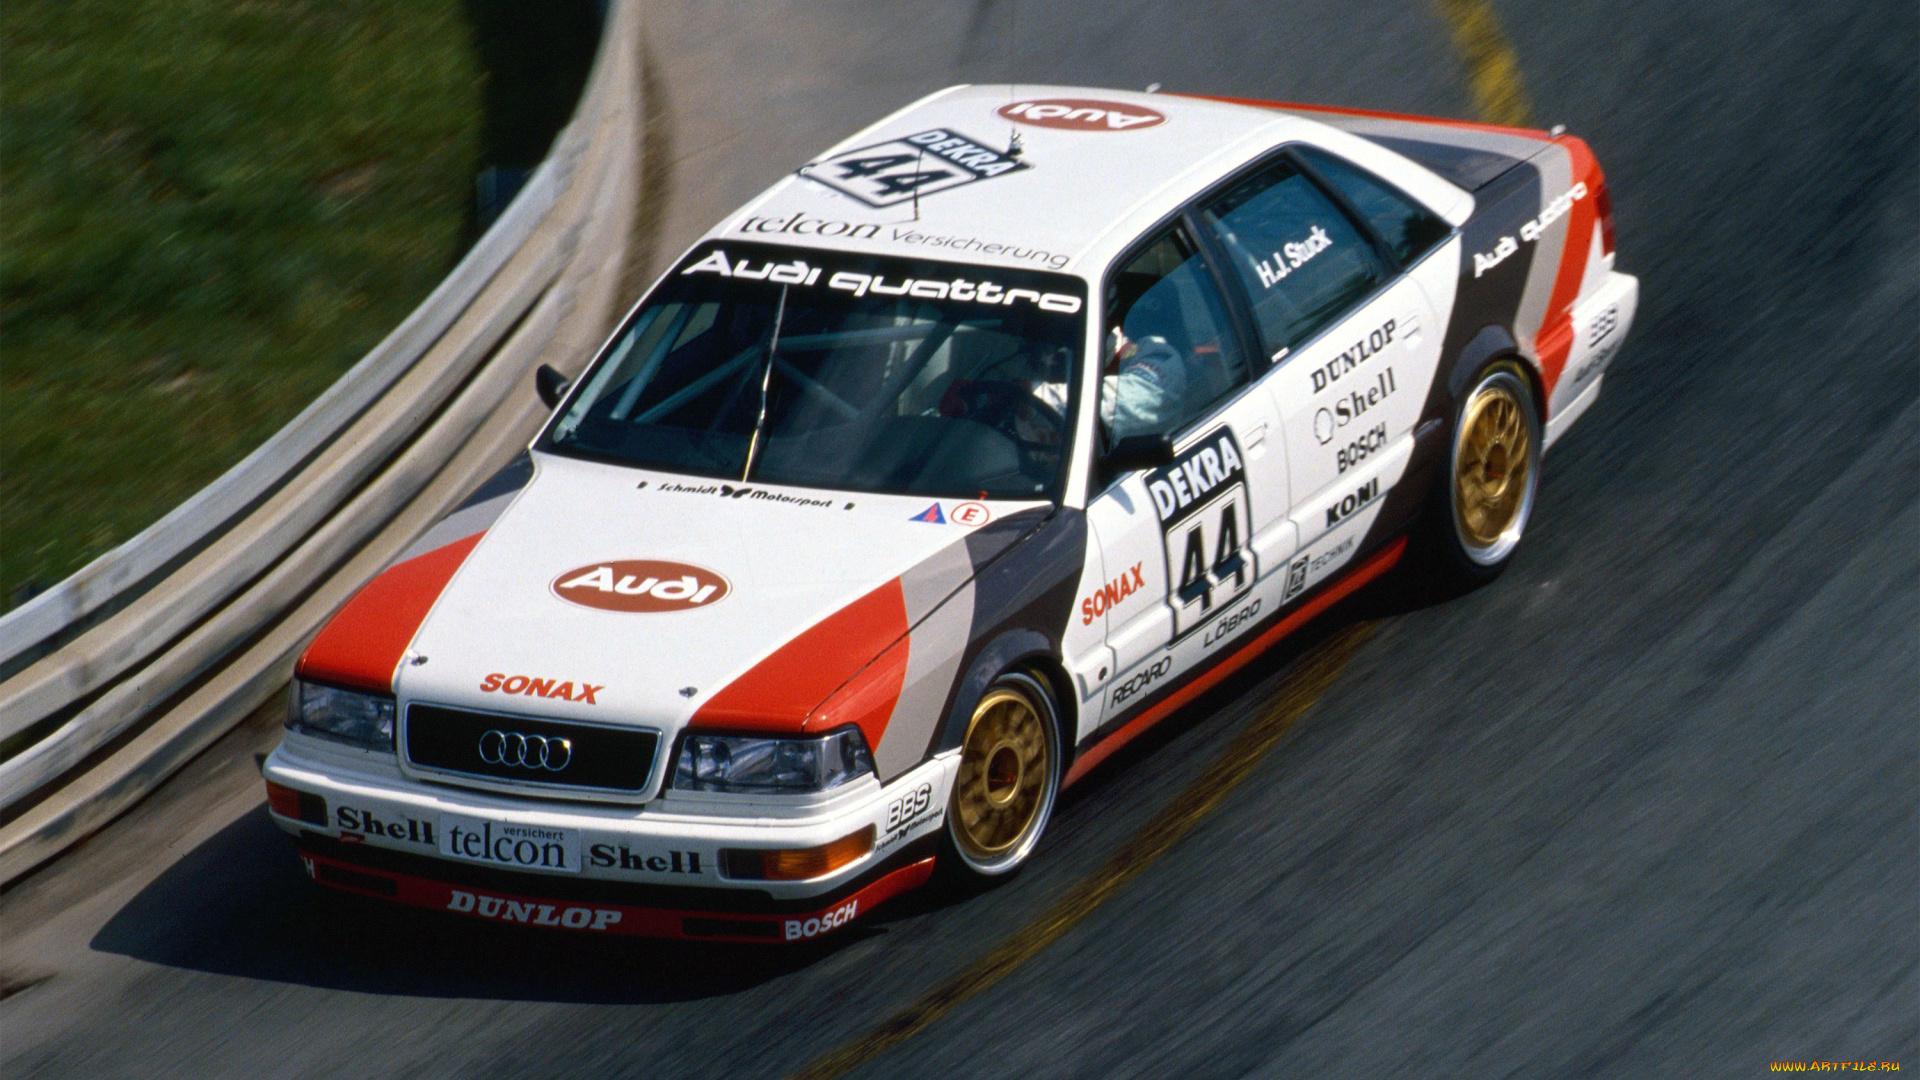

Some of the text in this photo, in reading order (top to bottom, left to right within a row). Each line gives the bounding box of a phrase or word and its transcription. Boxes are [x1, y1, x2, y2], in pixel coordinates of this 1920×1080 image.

[1006, 102, 1160, 129] Audi
[838, 153, 958, 198] 44
[907, 129, 1018, 179] DEKRA
[739, 212, 1073, 271] telcon Versicherung
[1473, 236, 1519, 279] Audi
[680, 250, 1082, 314] Audi quattro
[1310, 318, 1397, 394] DUNLOP
[1336, 366, 1398, 428] Shell
[1337, 421, 1388, 475] BOSCH
[658, 483, 833, 508] Schmidt Motorsport
[1150, 436, 1242, 521] DEKRA
[1326, 477, 1379, 528] KONI
[961, 508, 979, 523] E
[1177, 498, 1248, 616] 44
[559, 567, 717, 604] Audi
[1081, 562, 1145, 627] SONAX
[1203, 599, 1262, 649] LÖBRO
[480, 673, 605, 705] SONAX
[1110, 656, 1172, 709] RECARO
[336, 805, 436, 845] Shell
[886, 783, 932, 833] BBS
[450, 822, 567, 869] telcon
[503, 826, 564, 840] versichert
[590, 843, 703, 874] Shell
[447, 890, 622, 930] DUNLOP
[785, 900, 857, 940] BOSCH
